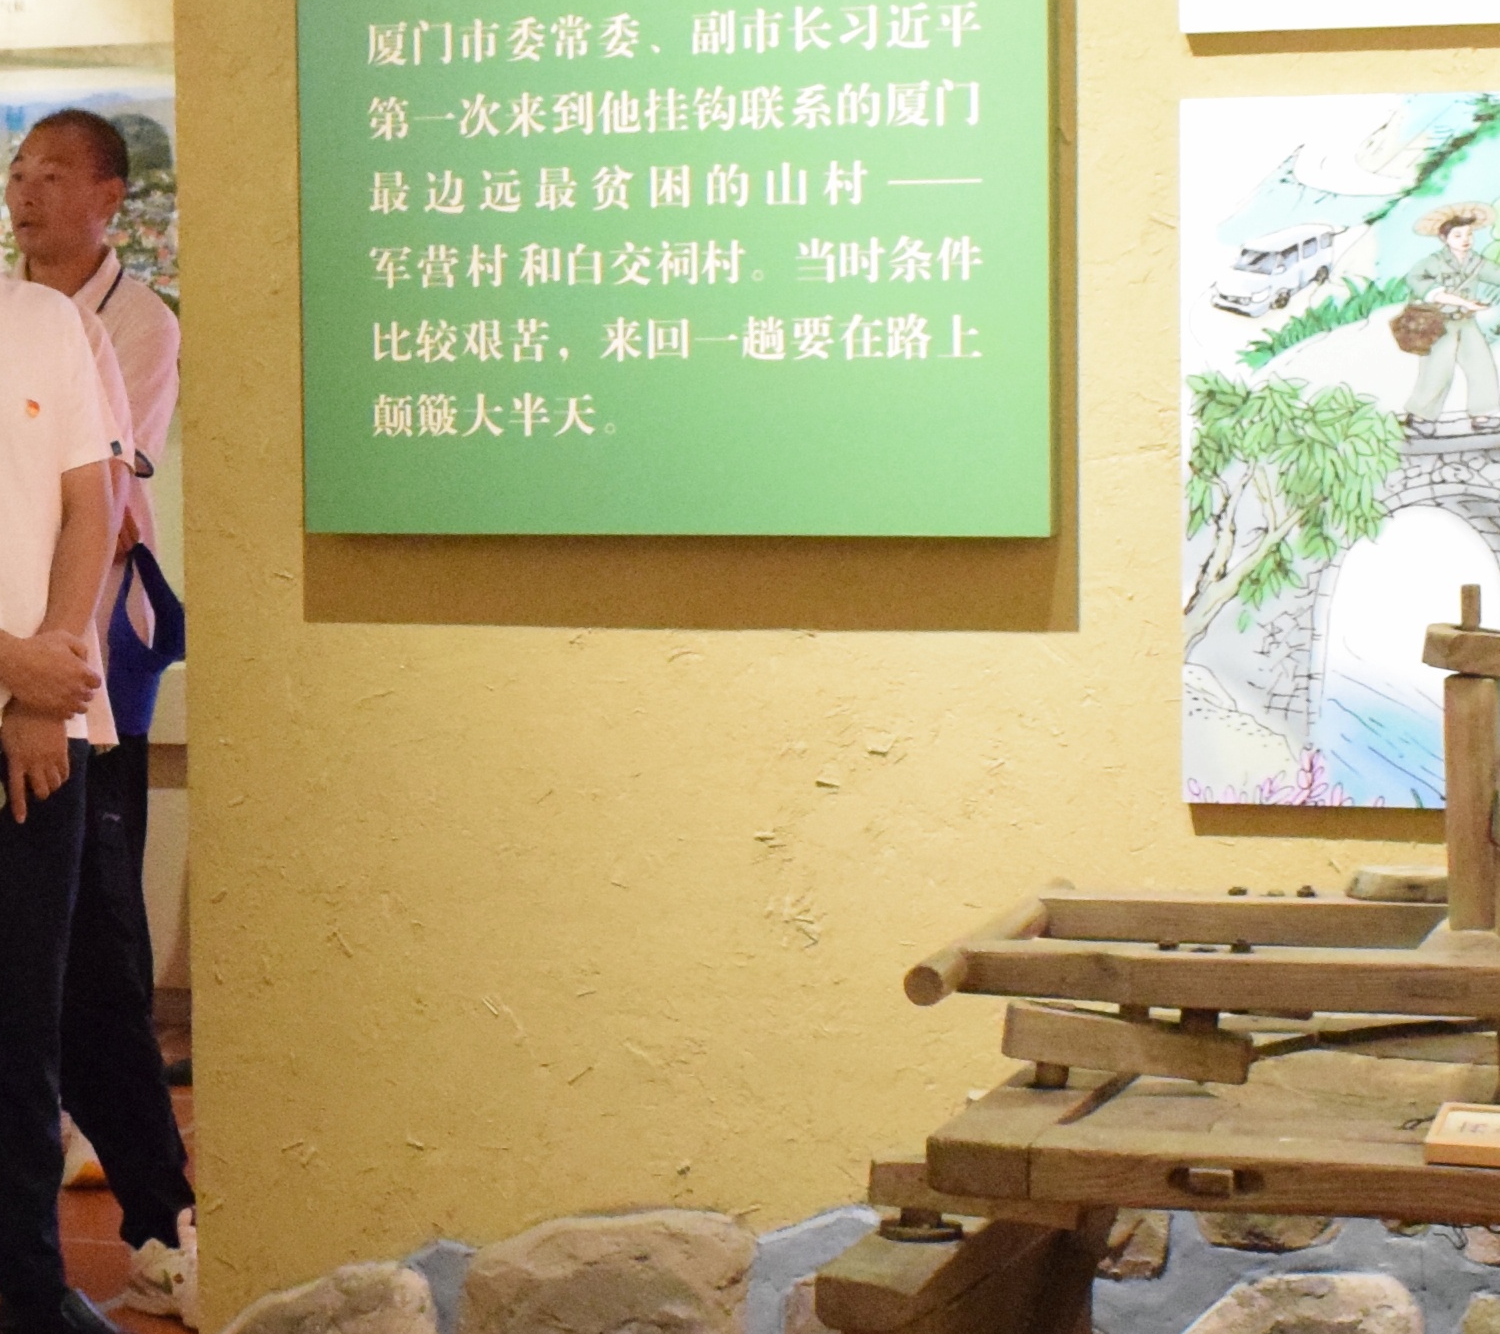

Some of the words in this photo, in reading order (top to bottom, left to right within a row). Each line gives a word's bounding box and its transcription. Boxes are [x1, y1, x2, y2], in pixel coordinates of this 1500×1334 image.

[366, 0, 981, 68] 厦门市委常委、副市长习近平
[366, 78, 981, 142] 第一次来到他挂钩联系的厦门
[369, 235, 982, 290] 军营村和白交祠村。当时条件
[371, 315, 982, 364] 比较艰苦，来回一趟要在路上
[371, 392, 619, 439] 颠簸大半天。
